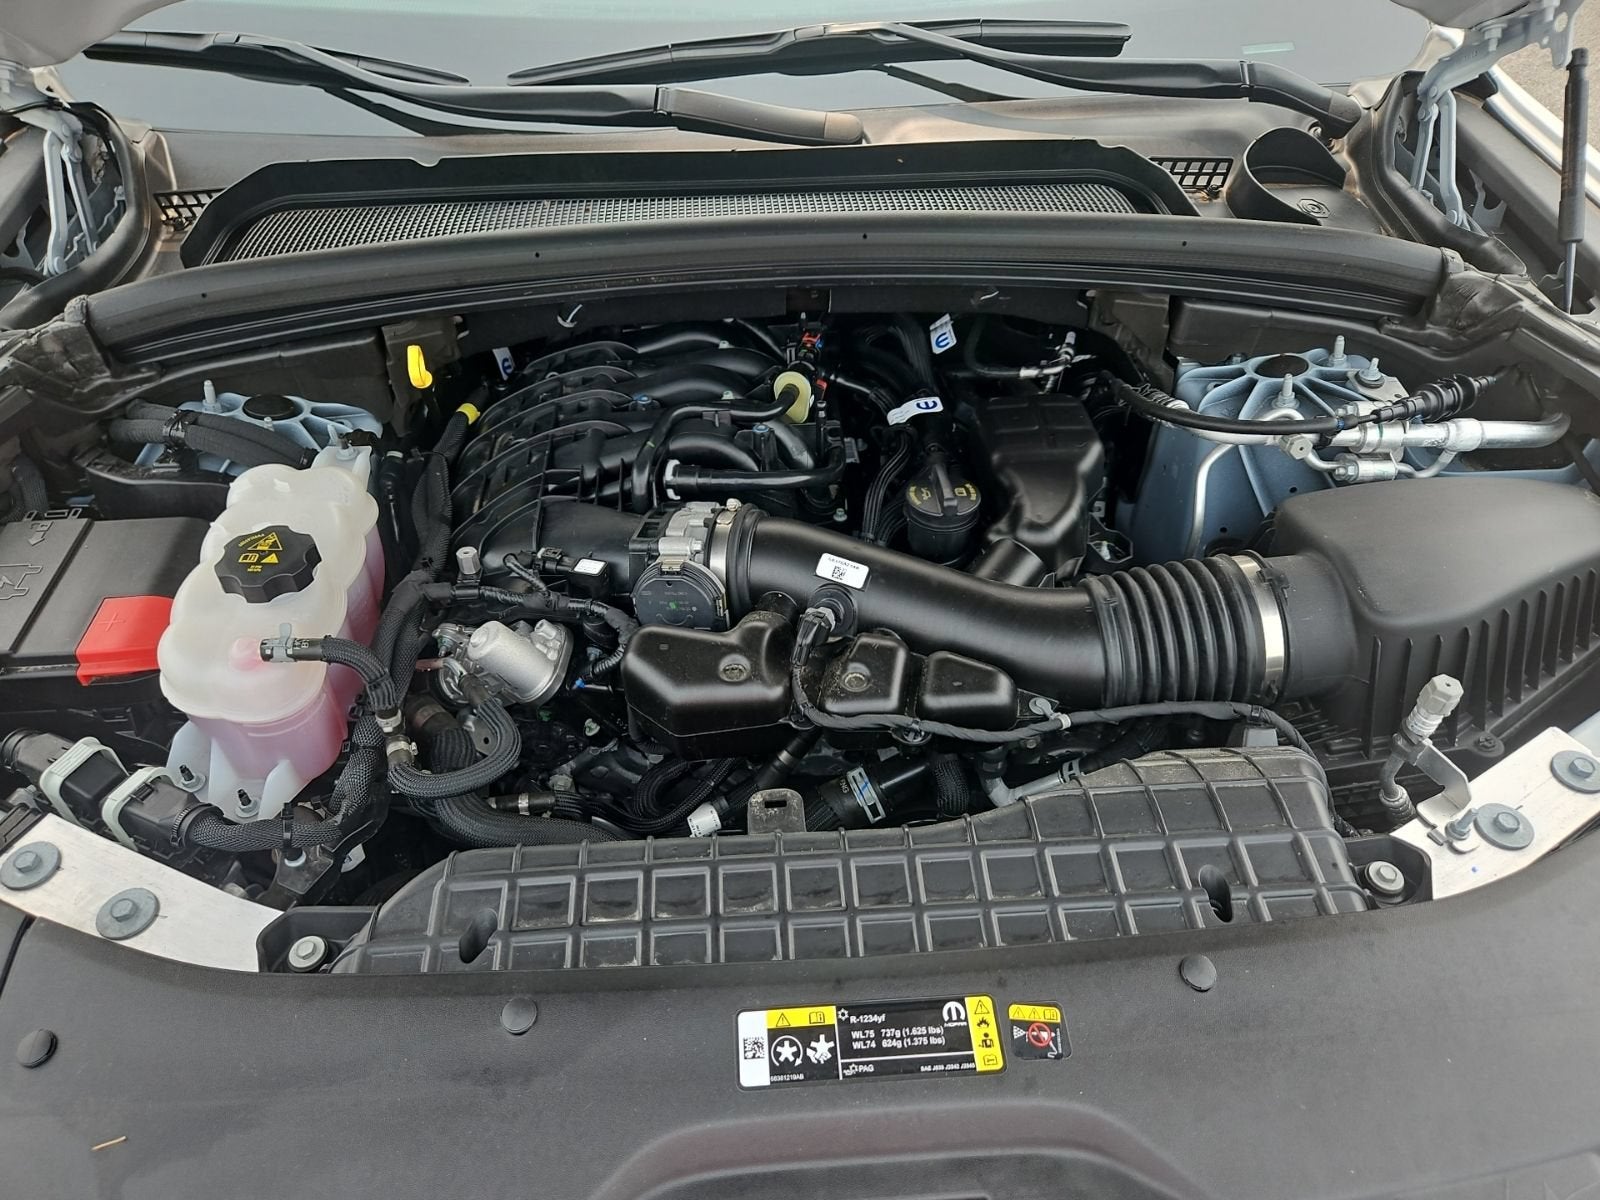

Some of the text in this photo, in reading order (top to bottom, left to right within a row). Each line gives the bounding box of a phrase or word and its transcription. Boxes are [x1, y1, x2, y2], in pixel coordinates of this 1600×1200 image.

[850, 1013, 886, 1024] R-1234yf
[851, 1025, 944, 1039] WL75 737g (1.625 lbs)
[852, 1035, 946, 1049] WL74 624g (1.375 lbs)
[858, 1064, 875, 1073] PAG
